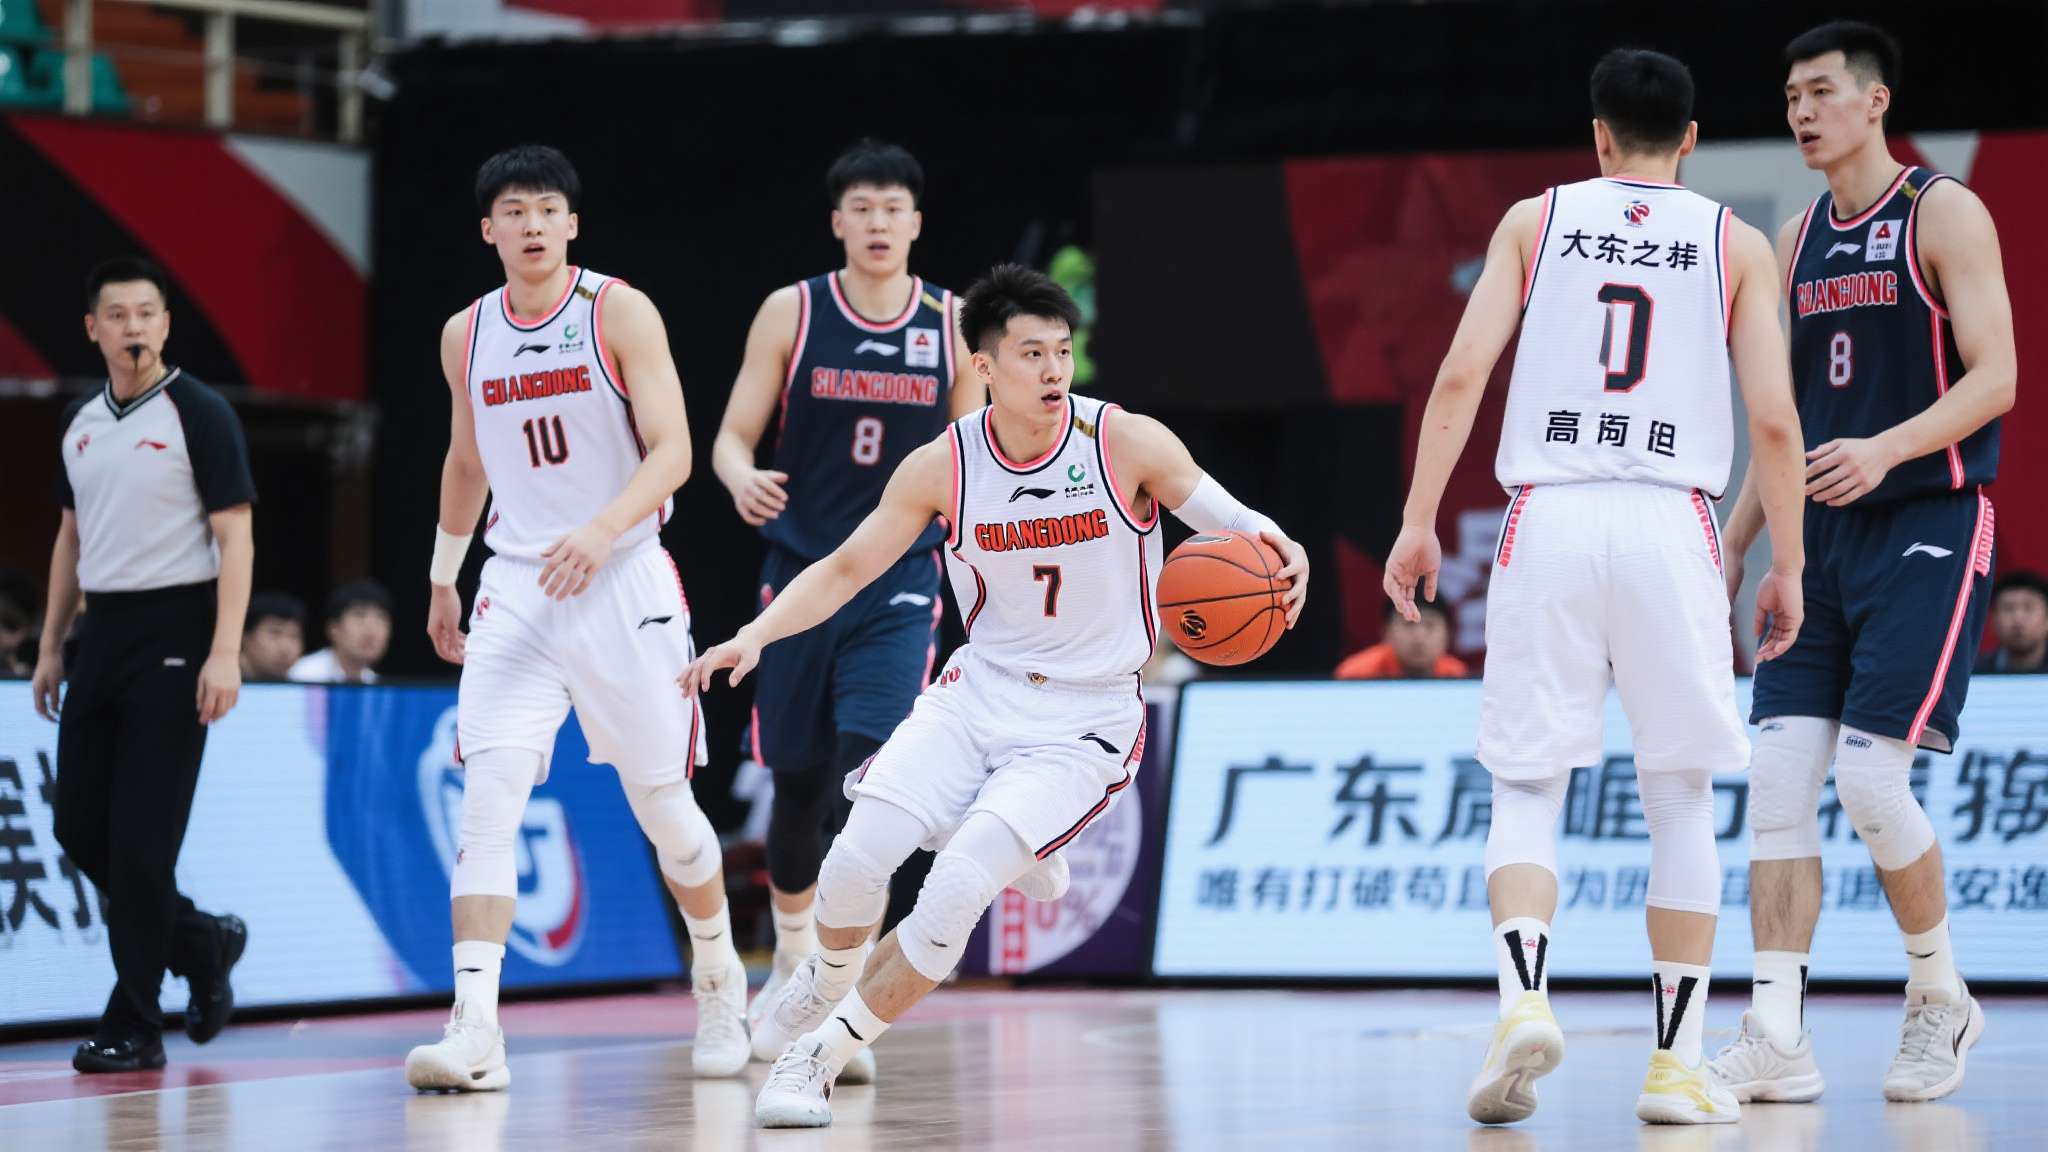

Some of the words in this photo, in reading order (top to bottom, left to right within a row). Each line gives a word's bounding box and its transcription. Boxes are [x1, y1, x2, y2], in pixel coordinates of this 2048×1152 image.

[1828, 330, 1853, 389] 8
[851, 414, 885, 466] 8
[1032, 563, 1063, 618] 7
